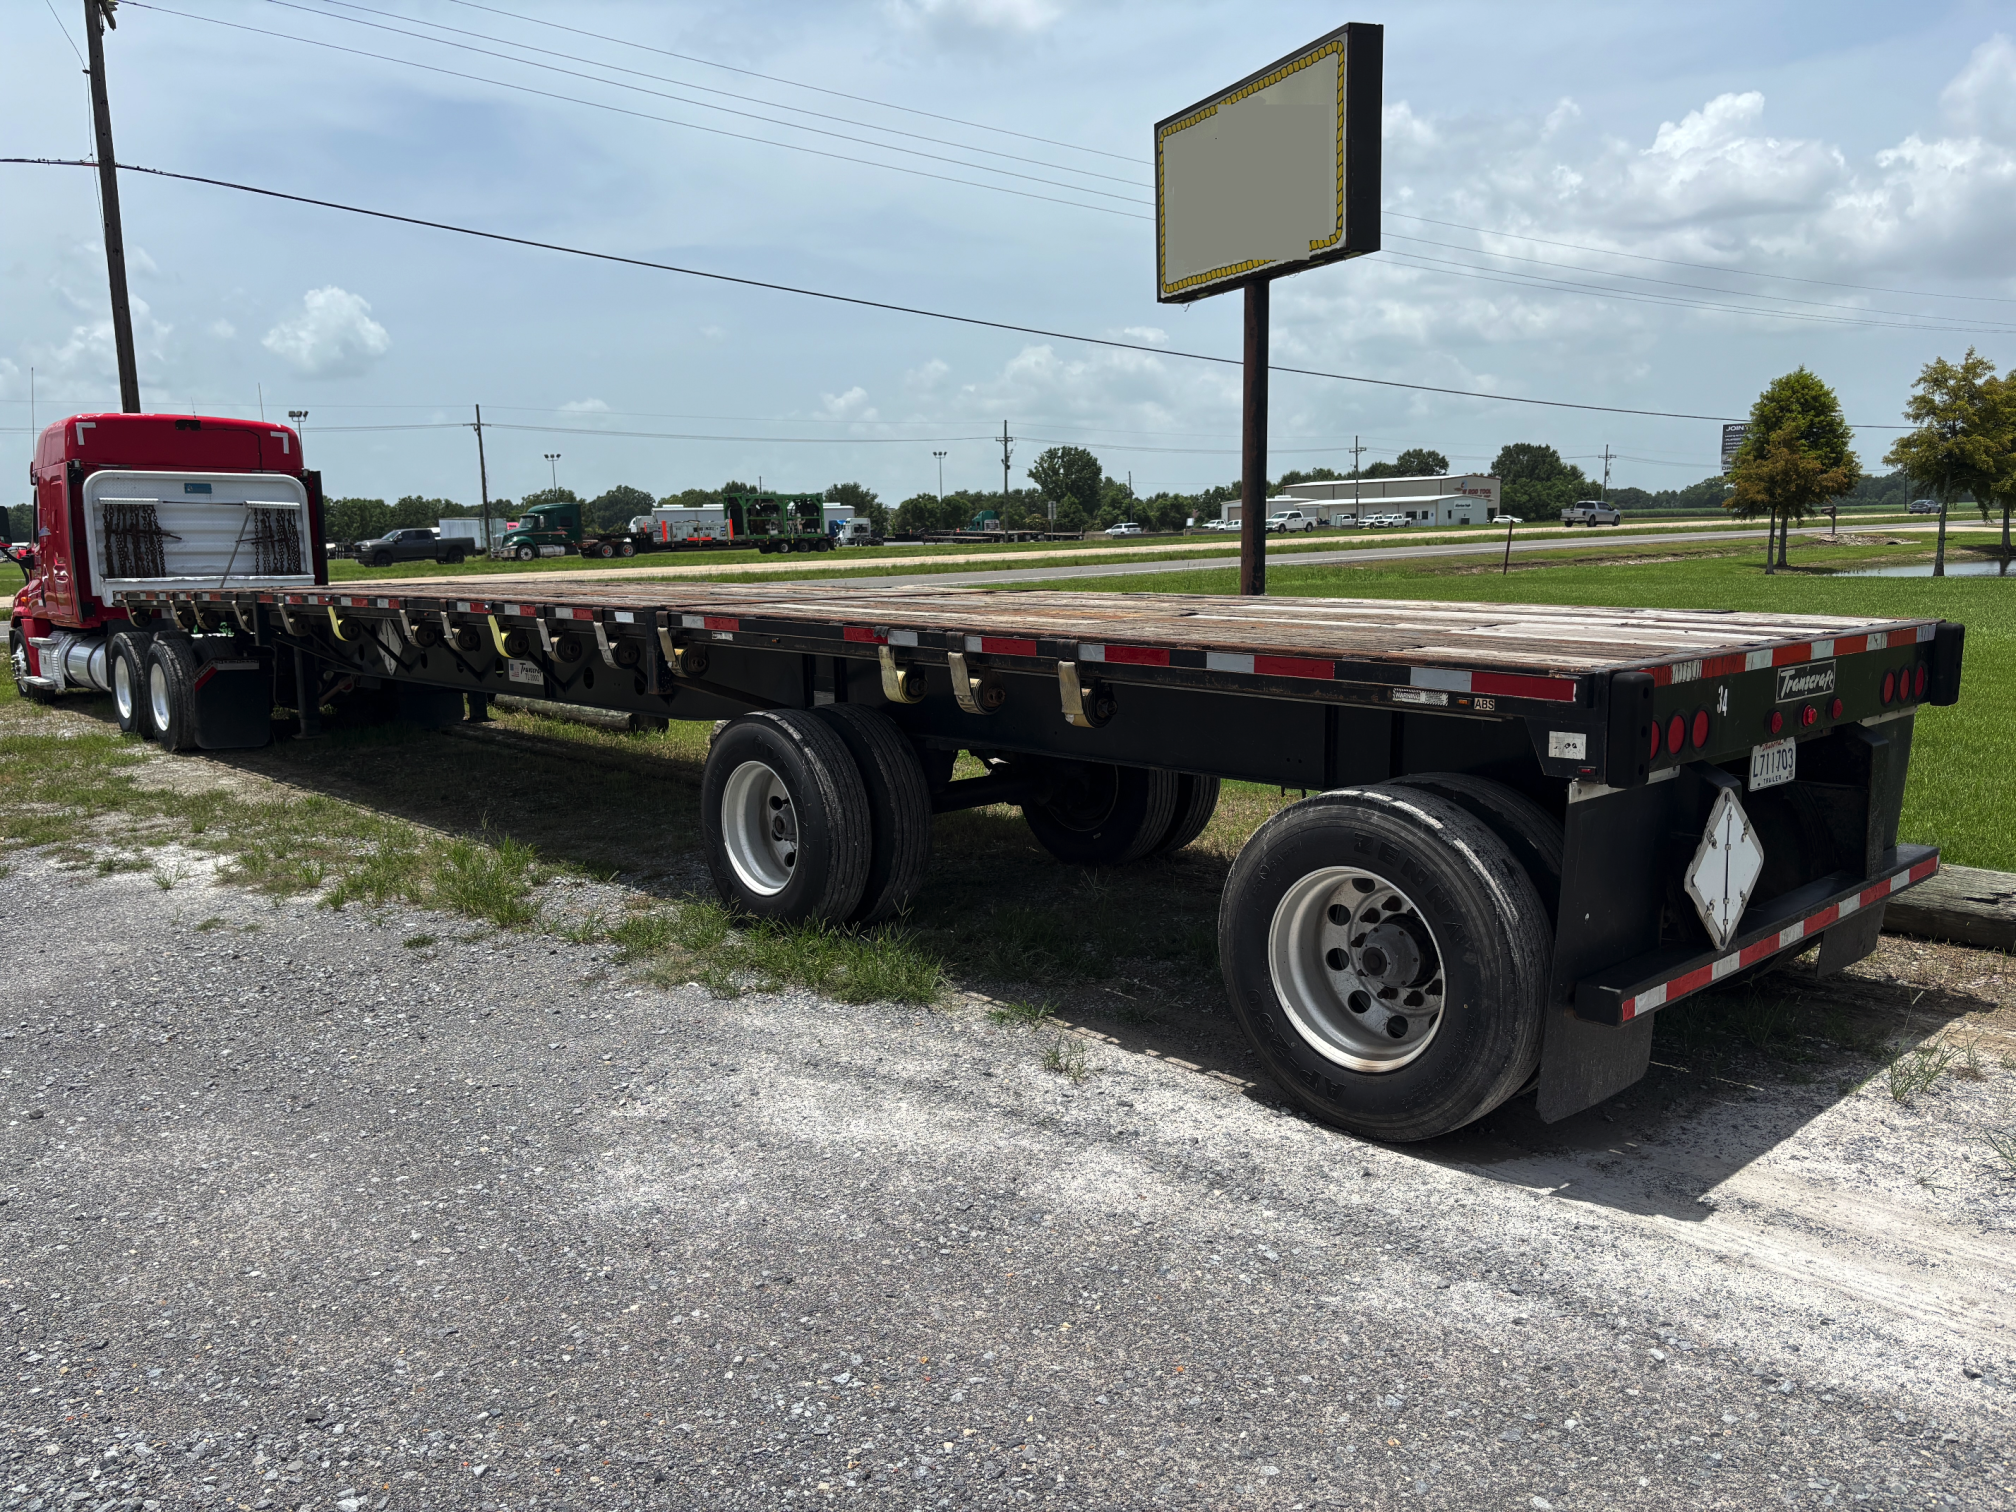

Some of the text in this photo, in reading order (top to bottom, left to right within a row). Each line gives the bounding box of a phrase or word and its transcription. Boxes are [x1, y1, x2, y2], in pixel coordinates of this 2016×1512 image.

[1780, 669, 1834, 699] Transcraft
[1395, 691, 1420, 700] WARNING
[1475, 698, 1494, 710] ABS
[1716, 684, 1728, 717] 34
[1753, 747, 1794, 778] L711703
[1763, 774, 1782, 785] TRAILER
